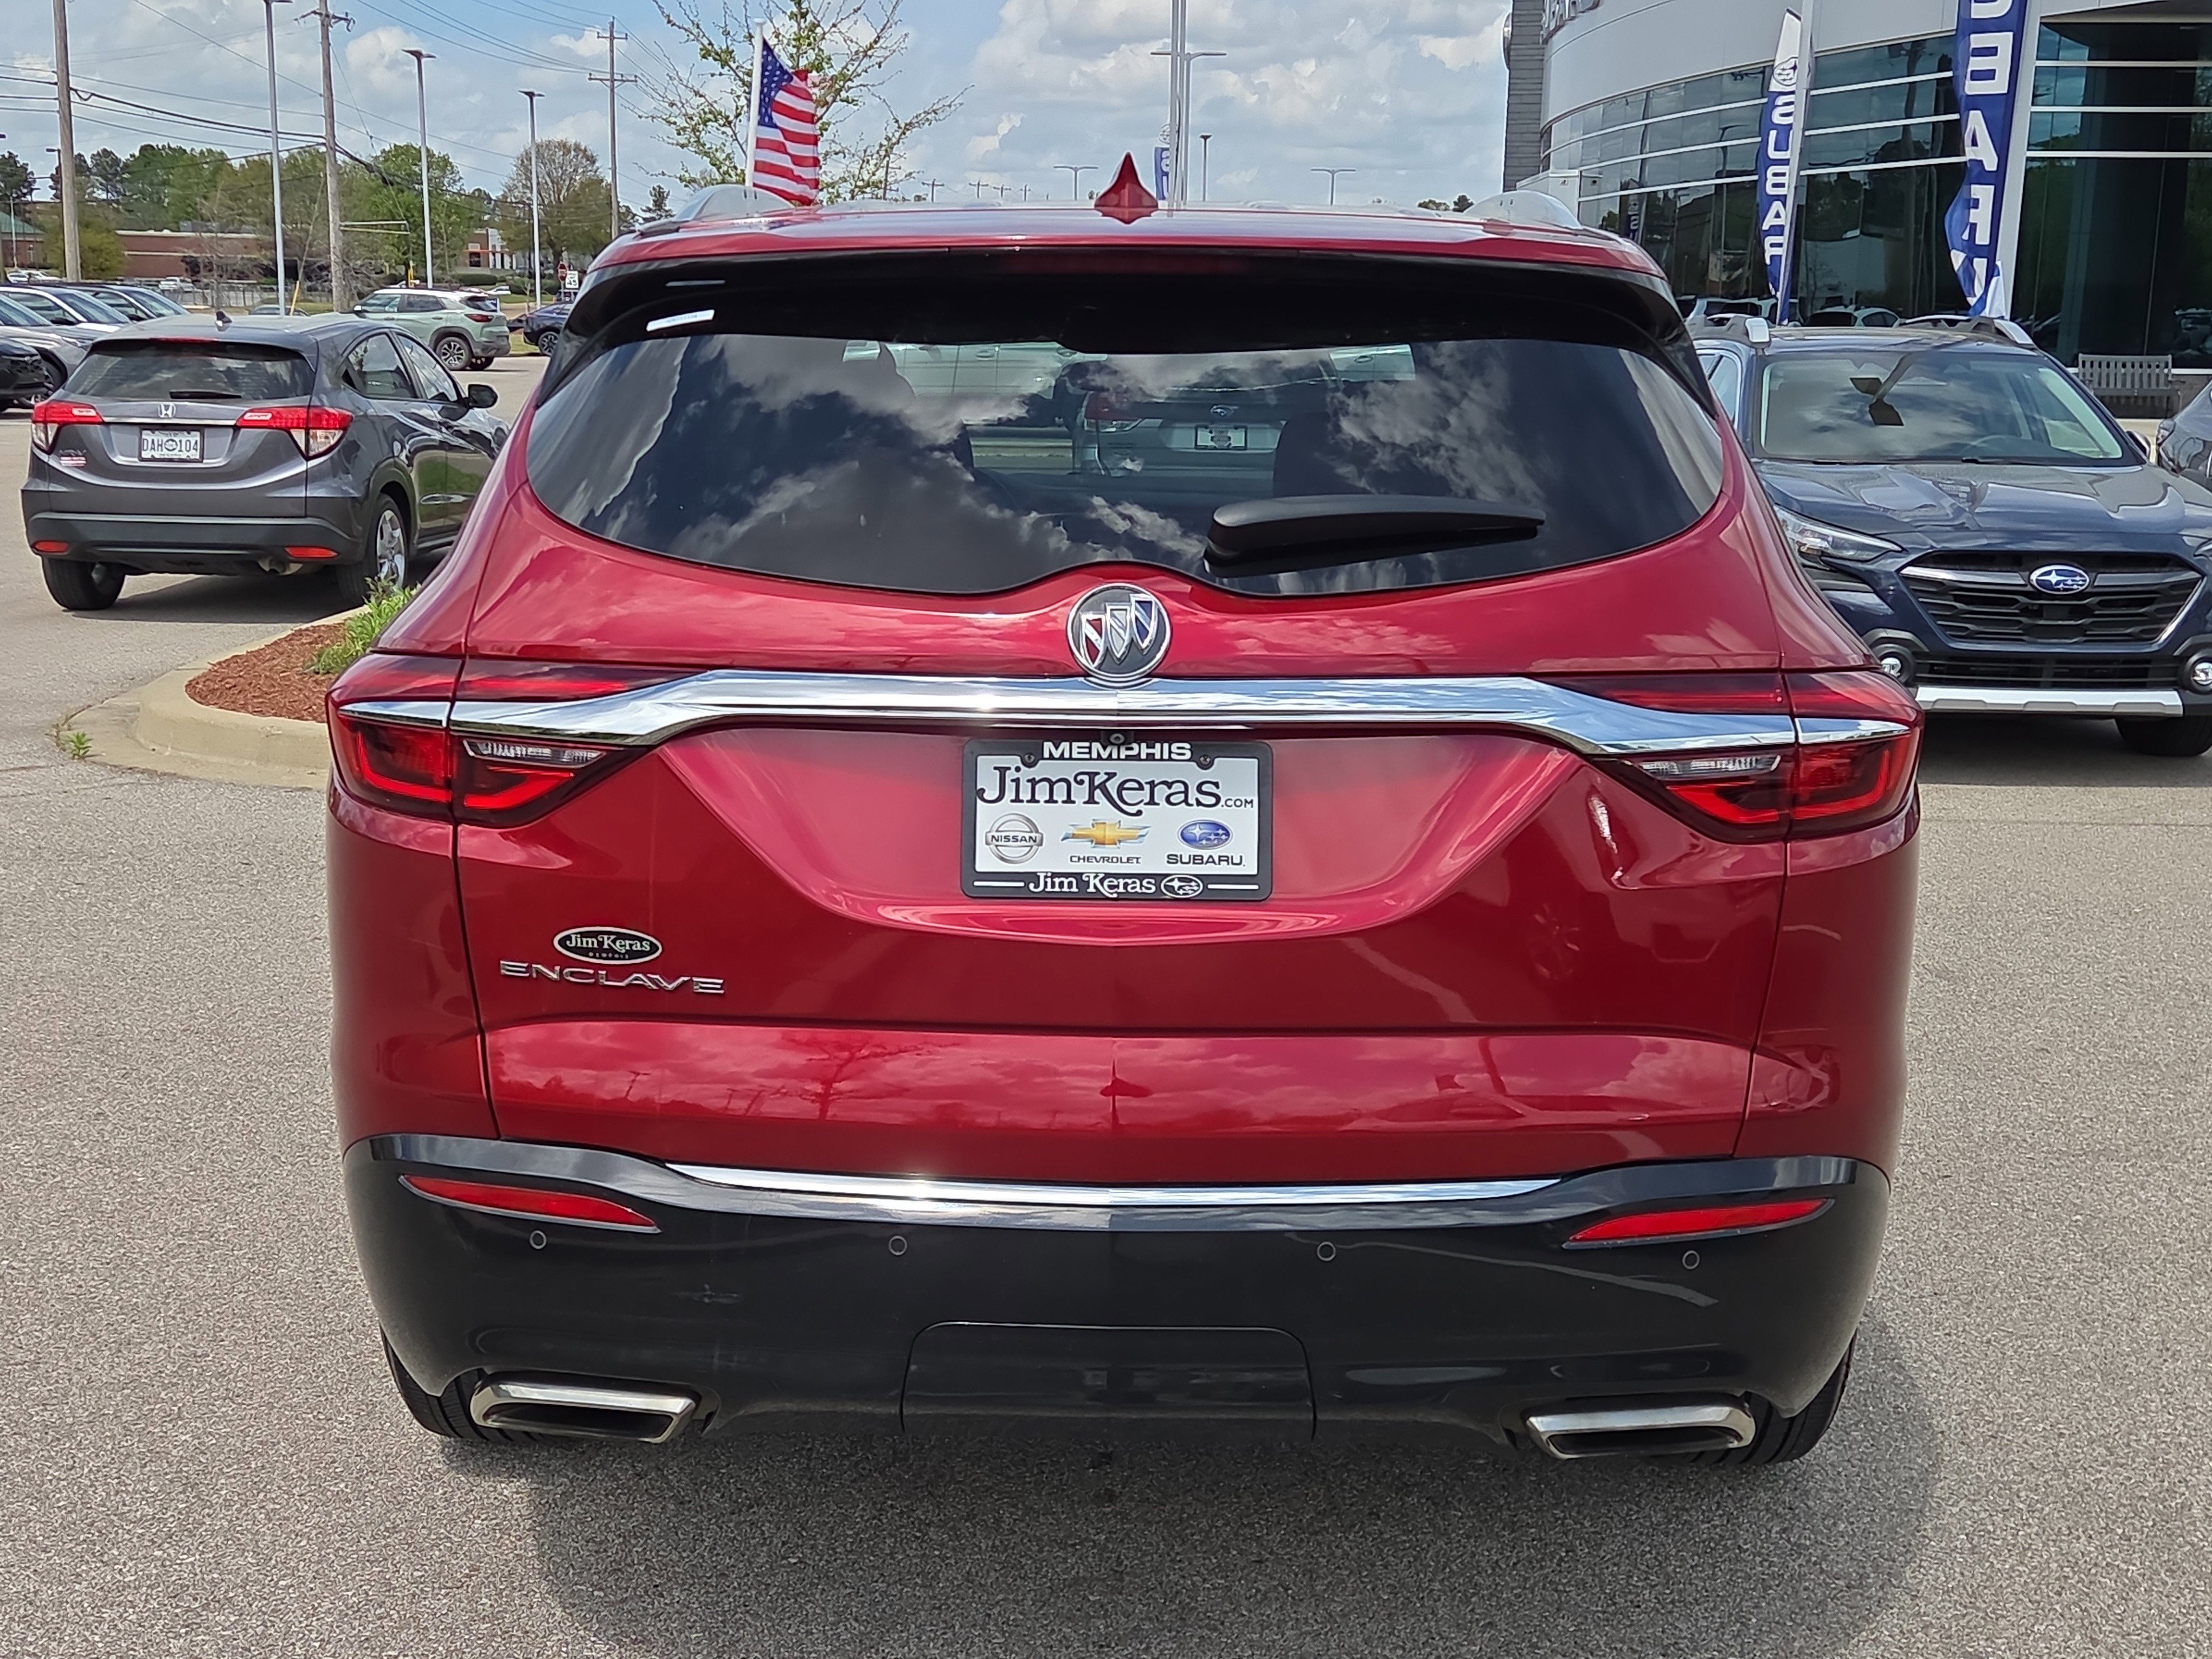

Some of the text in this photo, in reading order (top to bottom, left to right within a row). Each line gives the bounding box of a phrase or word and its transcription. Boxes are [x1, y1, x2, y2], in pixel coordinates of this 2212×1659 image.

[142, 438, 198, 452] DAH 104
[1043, 741, 1192, 760] MEMPHIS
[991, 834, 1038, 844] NISSAN
[1069, 854, 1142, 865] CHEVROLET
[1166, 853, 1244, 866] SUBARU
[1028, 872, 1156, 898] Jim Keras
[499, 960, 725, 994] ENCLAVE
